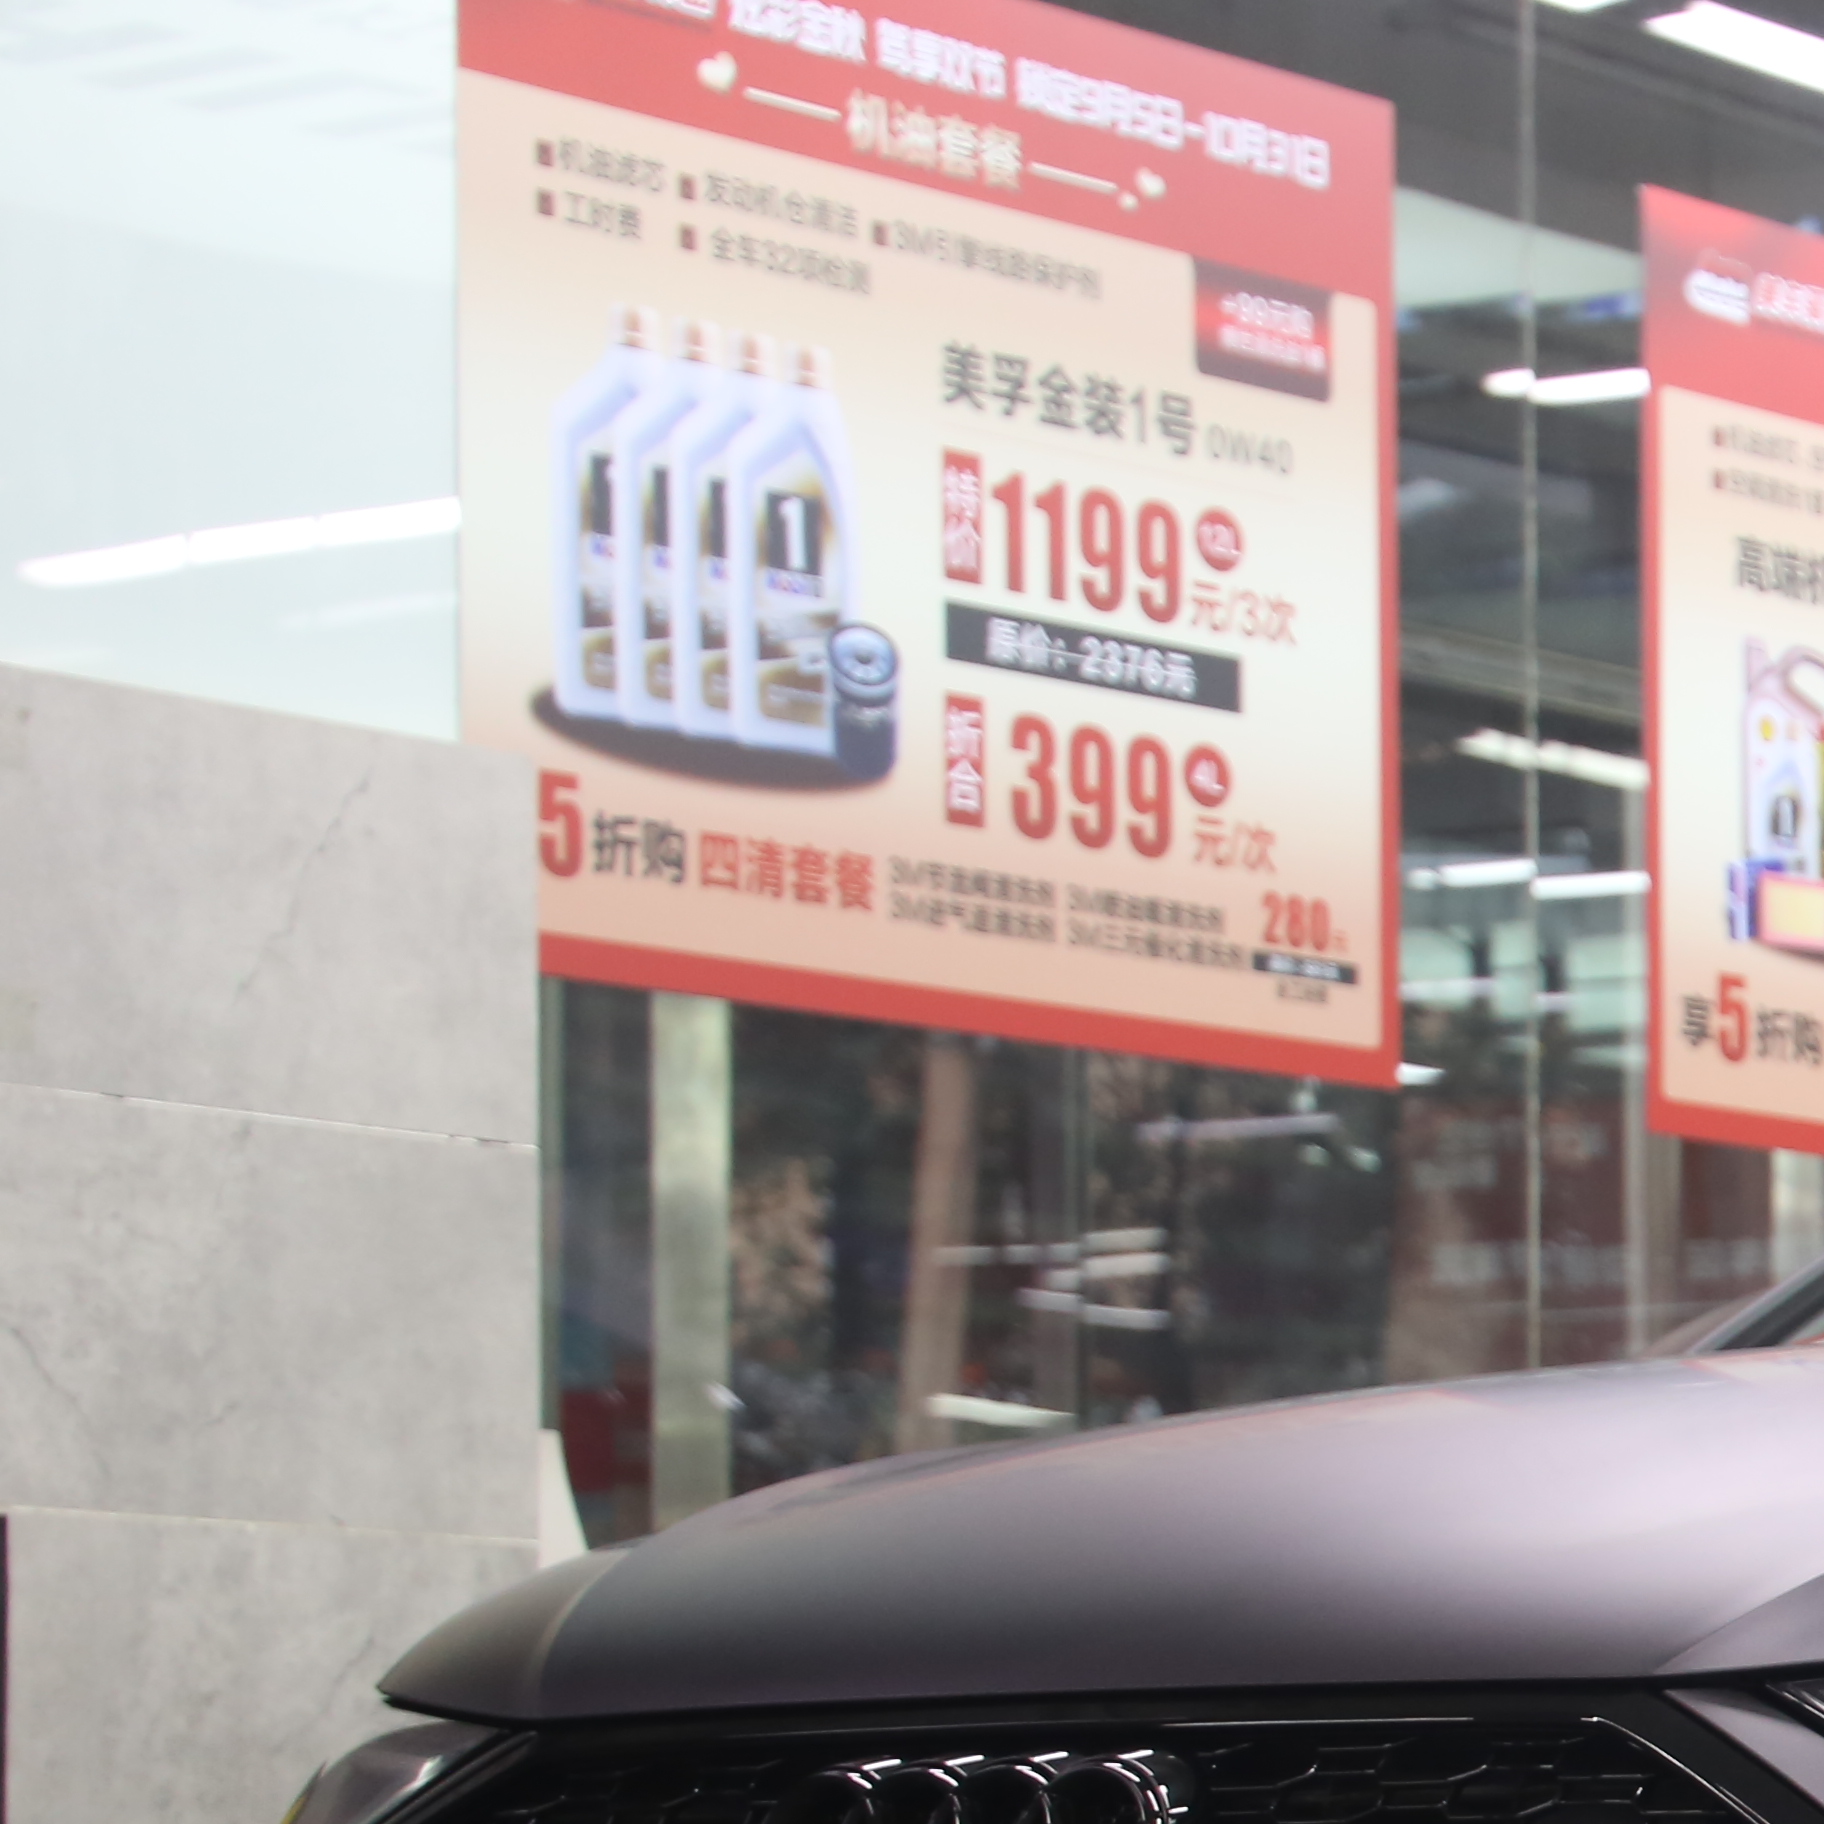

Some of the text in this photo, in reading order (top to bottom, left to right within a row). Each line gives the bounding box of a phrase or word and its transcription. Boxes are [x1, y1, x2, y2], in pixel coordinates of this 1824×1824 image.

[846, 87, 1022, 190] 机油套餐
[564, 190, 641, 239] 工时费
[943, 341, 1195, 456] 美孚金装1号
[943, 465, 981, 570] 特价
[992, 470, 1181, 624] 1199
[1192, 581, 1298, 646] 元/3次
[946, 705, 983, 813] 折合
[1012, 715, 1173, 858] 399
[700, 830, 873, 912] 四清套餐
[1194, 816, 1276, 873] 元/次
